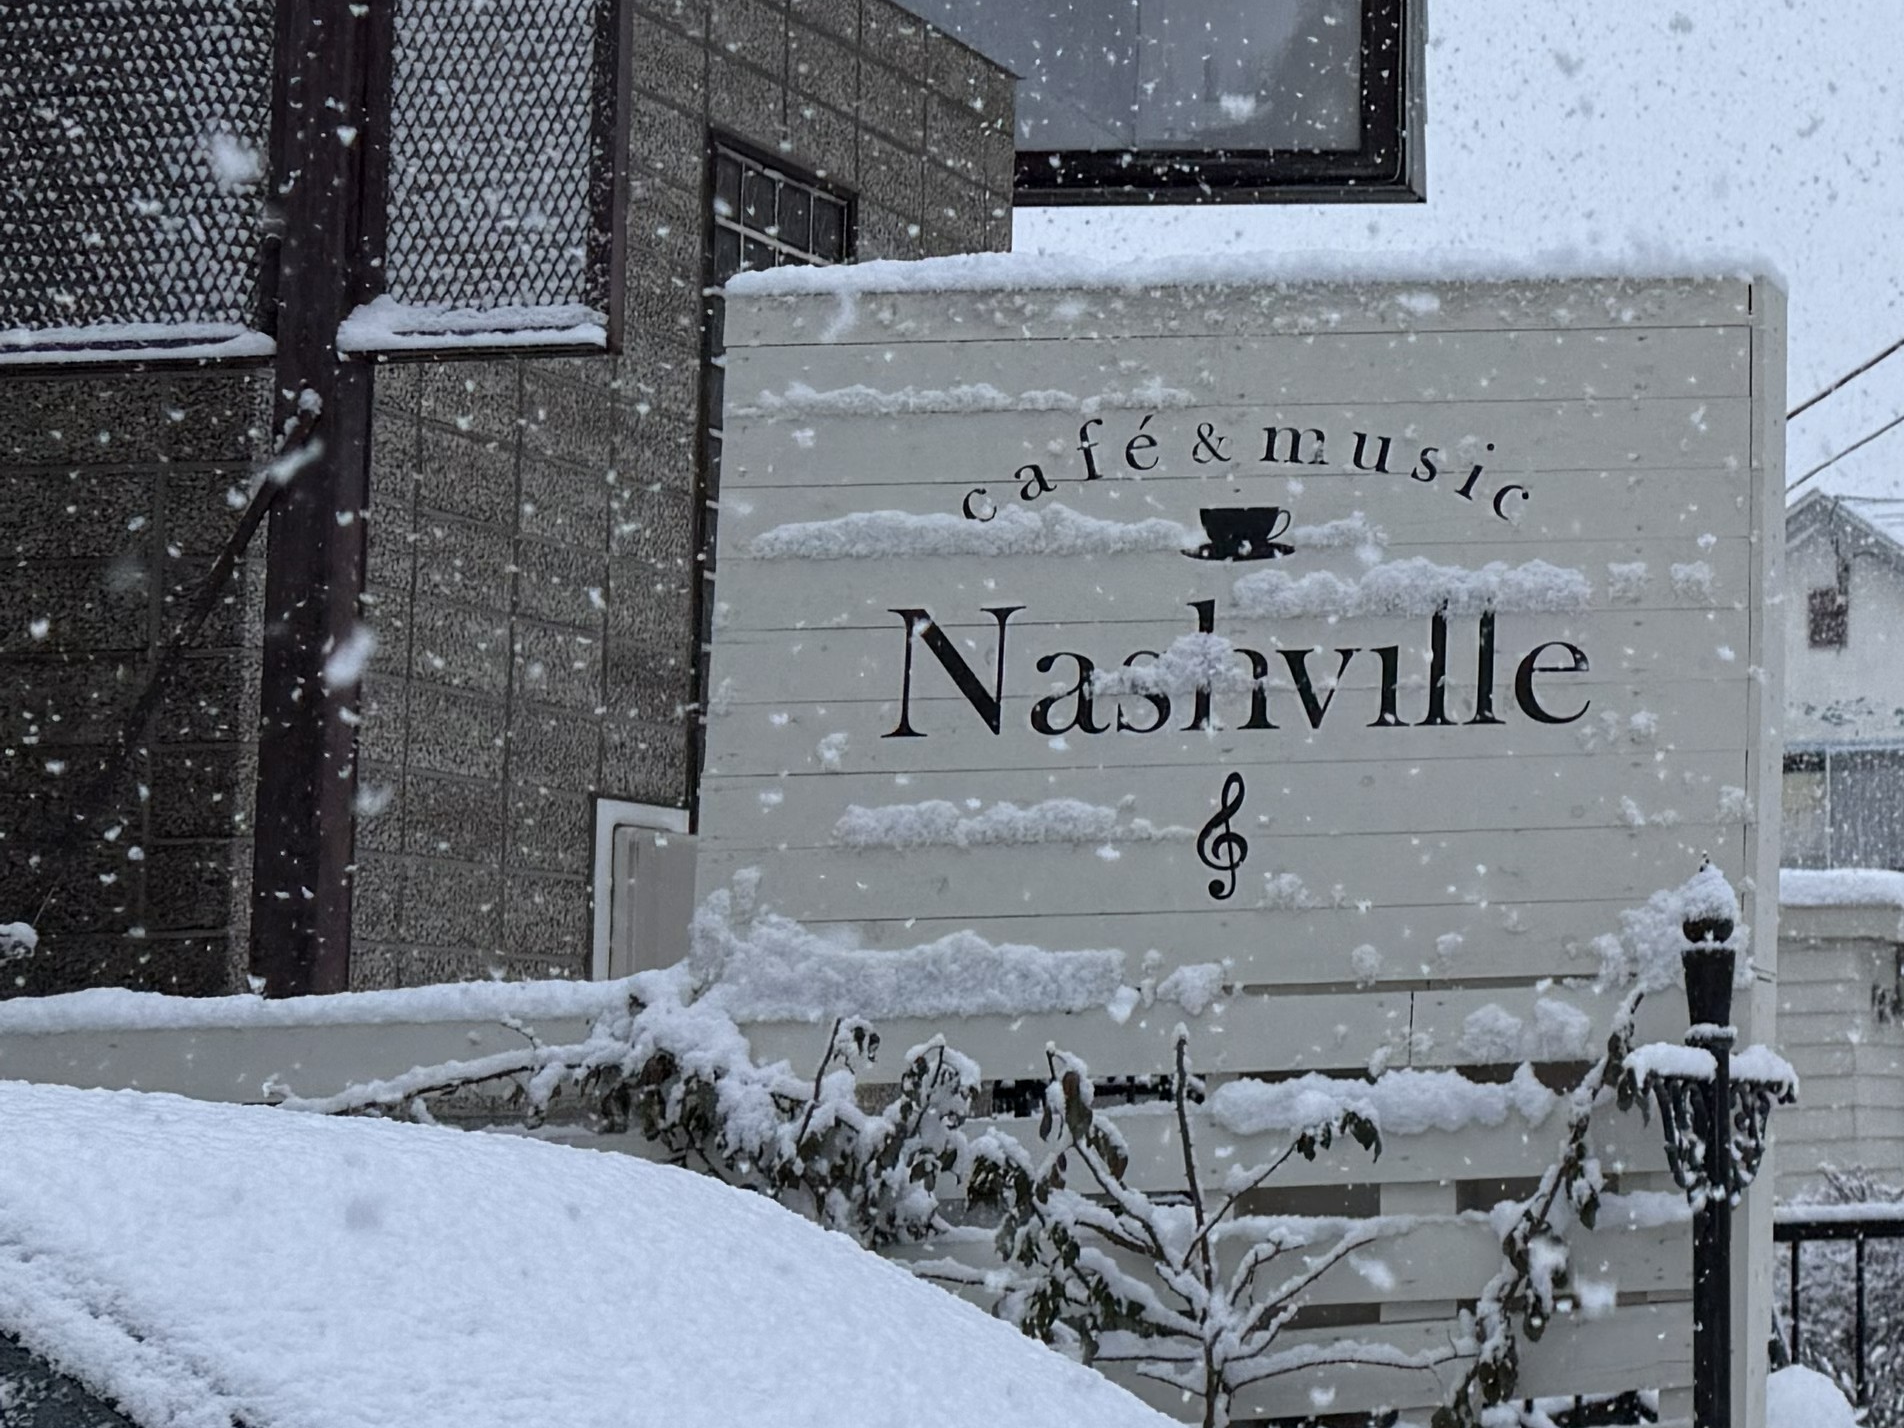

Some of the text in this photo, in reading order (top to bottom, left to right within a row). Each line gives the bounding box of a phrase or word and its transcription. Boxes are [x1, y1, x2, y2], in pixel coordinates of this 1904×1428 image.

[962, 414, 1530, 522] café & music
[880, 598, 1591, 738] Nashville
